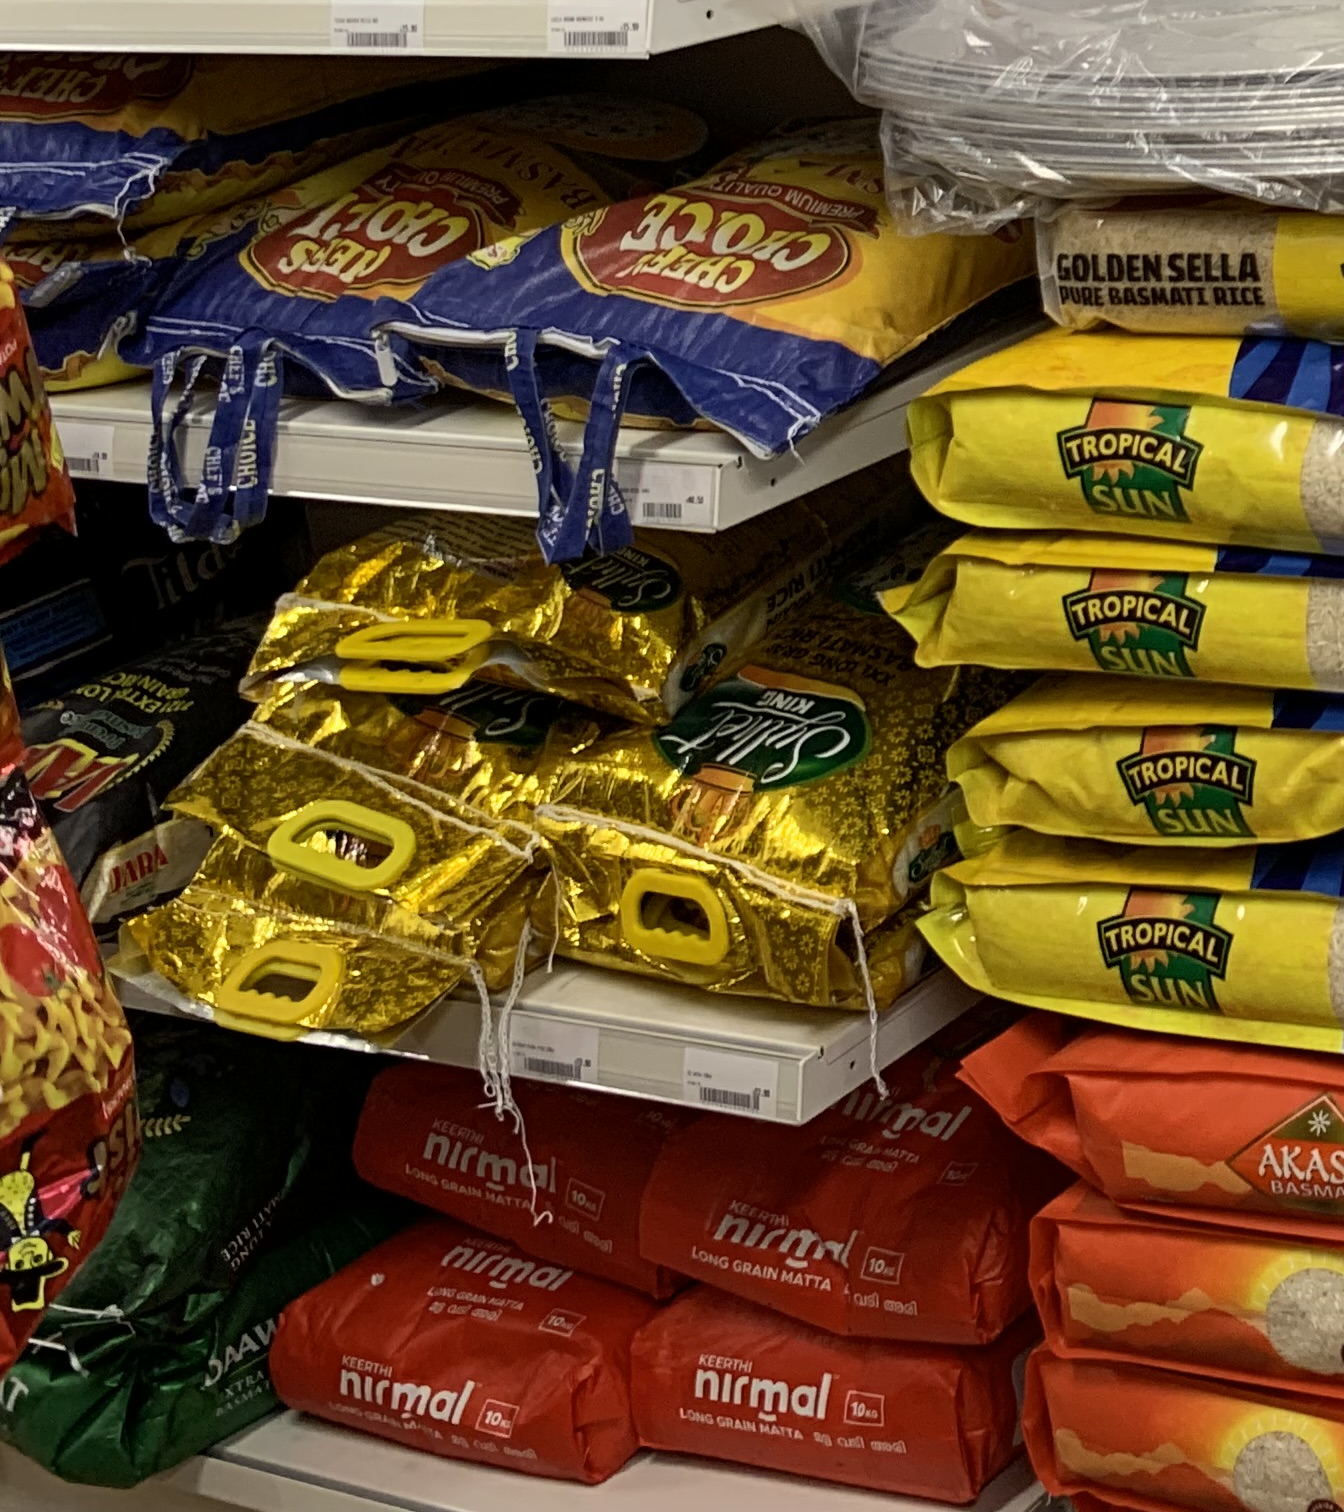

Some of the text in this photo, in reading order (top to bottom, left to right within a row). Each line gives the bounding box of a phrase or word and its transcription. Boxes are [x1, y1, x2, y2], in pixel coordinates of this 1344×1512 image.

[784, 185, 863, 219] PREMIUM
[1056, 251, 1261, 285] GOLDEN SELLA
[1058, 285, 1266, 307] PURE BASMATI RICE
[1064, 432, 1190, 477] TROPICAL
[1092, 484, 1174, 518] SUN
[1070, 593, 1193, 637] TROPICAL
[1100, 644, 1184, 677] SUN
[756, 689, 816, 714] KING
[659, 701, 851, 785] Sylhet
[1127, 755, 1245, 791] TROPICAL
[1157, 805, 1241, 836] SUN
[1105, 921, 1221, 967] TROPICAL
[1130, 972, 1207, 1012] SUN
[423, 1132, 556, 1193] nirmal
[729, 1200, 790, 1225] KEERTHI
[713, 1213, 858, 1269] nirmal
[441, 1244, 574, 1292] nirmal
[691, 1246, 832, 1291] LONG GRAIN MATTA
[342, 1354, 393, 1377] KEERTHI
[699, 1353, 753, 1373] KEERTHI
[340, 1368, 475, 1425] nirmal
[695, 1369, 832, 1419] nirmal
[851, 1402, 878, 1419] 10KG
[679, 1407, 804, 1440] LONG GRAIN MATTA
